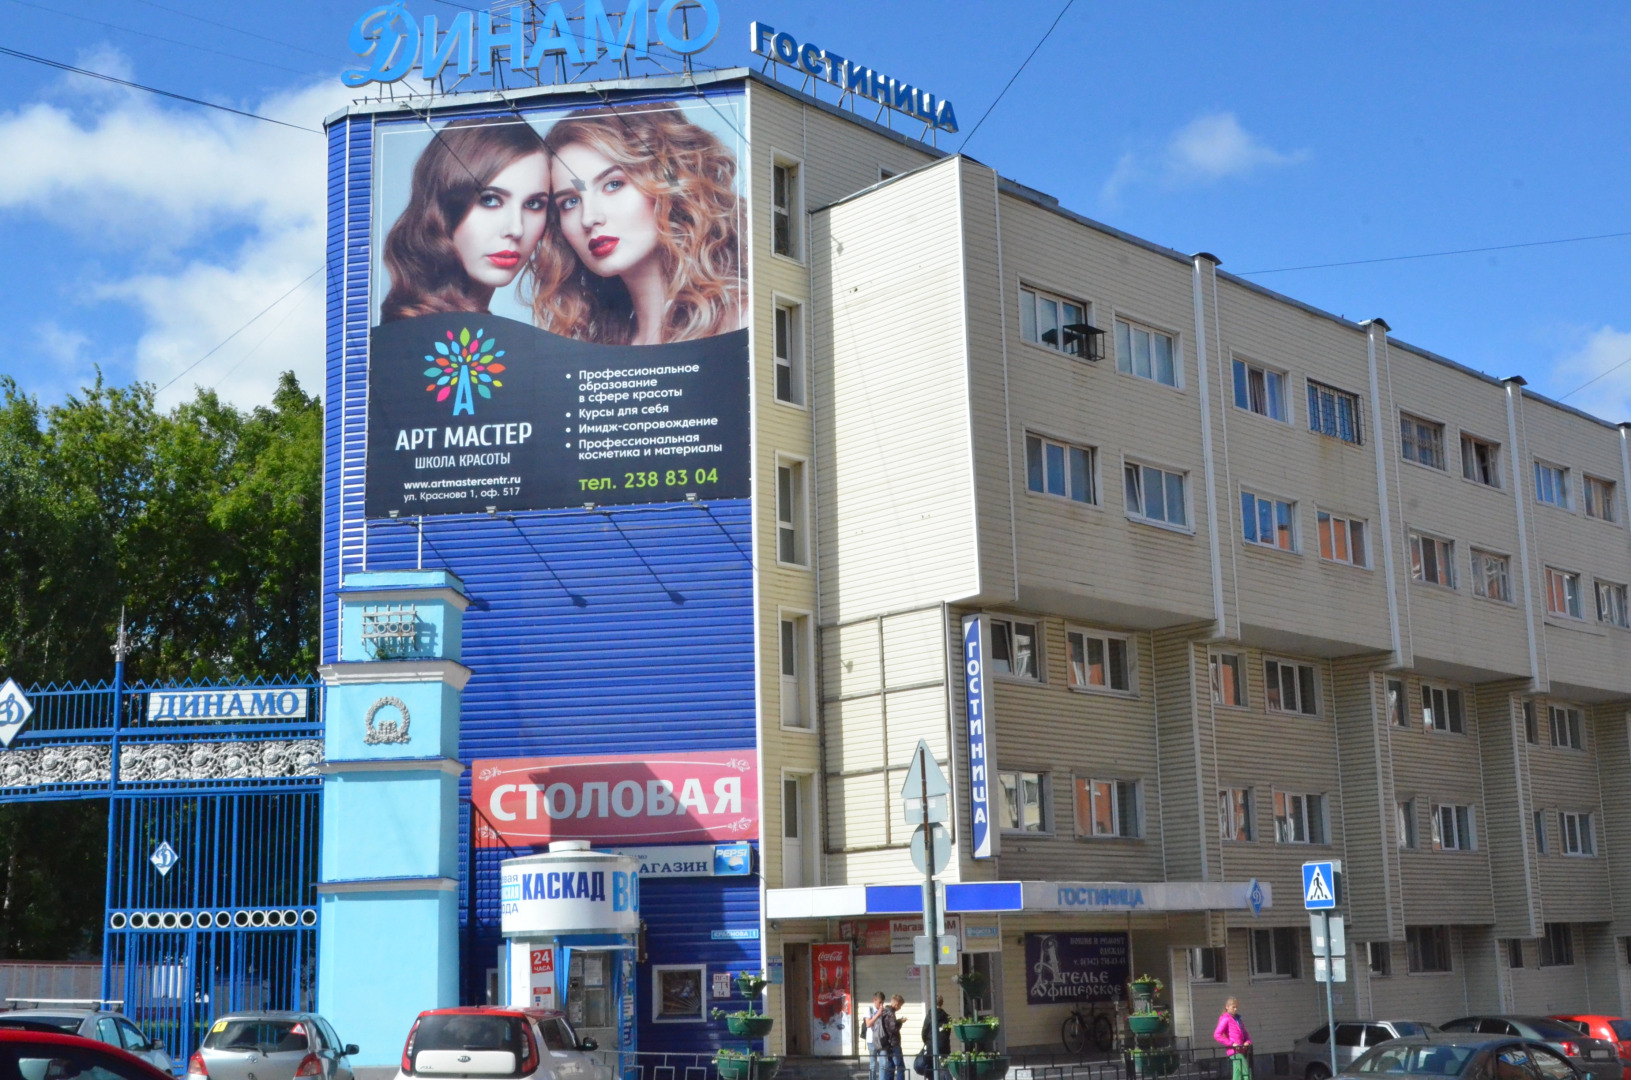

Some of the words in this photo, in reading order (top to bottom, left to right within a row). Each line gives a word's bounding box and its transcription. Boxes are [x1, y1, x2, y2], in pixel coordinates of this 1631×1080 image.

[341, 0, 720, 88] ДИНАМО
[750, 20, 959, 133] ГОСТИНИЦА
[579, 364, 700, 381] Профессиональное
[579, 378, 658, 392] образование
[588, 391, 630, 404] сфере
[632, 388, 683, 401] красоты
[579, 408, 614, 420] Курсы
[617, 406, 638, 417] для
[641, 403, 669, 415] себя
[579, 417, 719, 434] Имидж-сопровождение
[395, 428, 437, 450] АРТ
[444, 422, 532, 448] МАСТЕР
[579, 434, 700, 451] Профессиональная
[579, 448, 641, 460] косметика
[643, 448, 651, 456] и
[654, 443, 723, 457] материалы
[415, 455, 456, 469] ШКОЛА
[459, 452, 511, 467] КРАСОТЫ
[404, 476, 521, 490] www.artmastercentr.ru
[579, 477, 617, 491] тел.
[624, 471, 658, 488] 238
[665, 469, 688, 486] 83
[695, 468, 719, 484] 04
[403, 493, 417, 503] ул.
[420, 490, 467, 502] Краснова
[470, 489, 478, 499] 1,
[480, 487, 500, 499] оф.
[503, 487, 520, 496] 517
[153, 690, 300, 721] ДИНАМО
[967, 641, 986, 824] ГОСТИНИЦА
[489, 777, 742, 821] СТОЛОВАЯ
[716, 848, 747, 857] PEPSI
[639, 861, 708, 874] АГАЗИН
[522, 871, 606, 901] КАСКАД
[1058, 887, 1145, 908] ГОСТИНИЦА
[533, 950, 550, 964] 24
